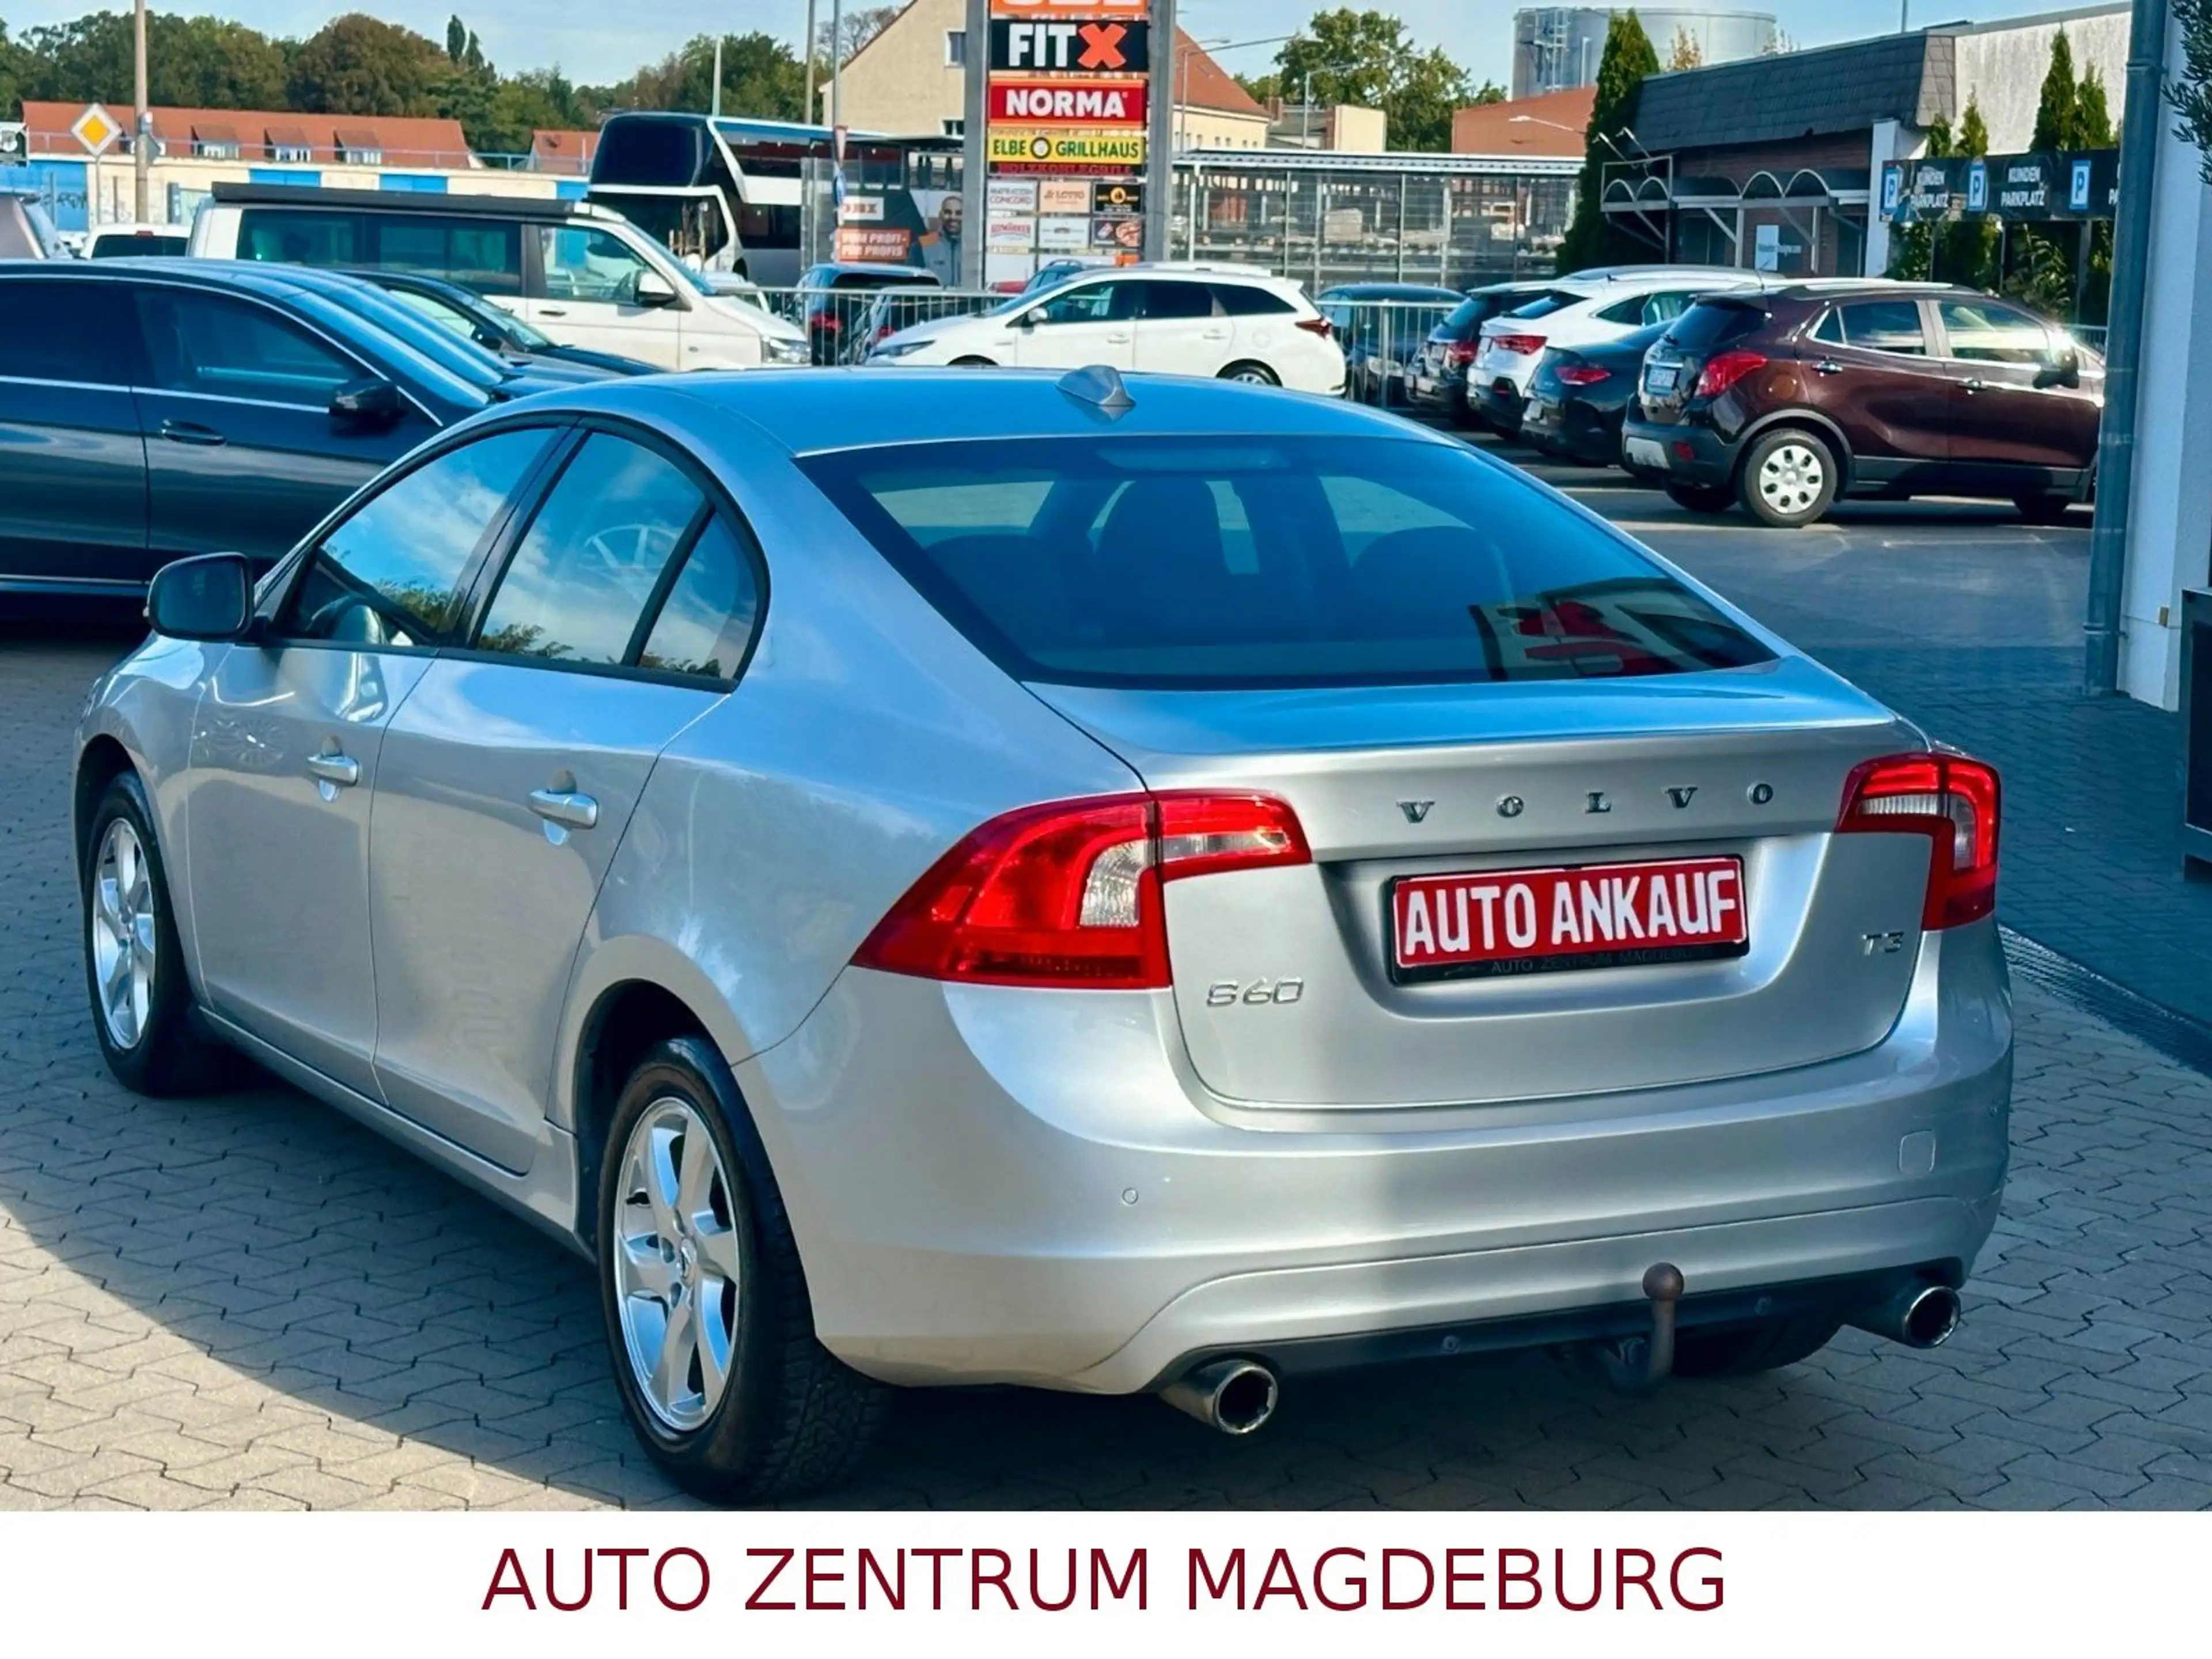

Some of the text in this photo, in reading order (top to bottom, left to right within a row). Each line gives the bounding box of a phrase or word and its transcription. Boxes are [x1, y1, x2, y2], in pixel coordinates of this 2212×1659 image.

[1009, 23, 1127, 69] FITX
[1006, 89, 1126, 118] NORMA
[993, 139, 1139, 158] ELBE GRILLHAUS
[2008, 166, 2041, 183] KUNDEN
[2001, 190, 2045, 207] PARKPLATZ
[1396, 782, 1774, 824] VOLVO
[1405, 869, 1735, 956] AUTO ANKAUF
[1491, 960, 1533, 974] AUTO
[1207, 976, 1304, 1007] S60
